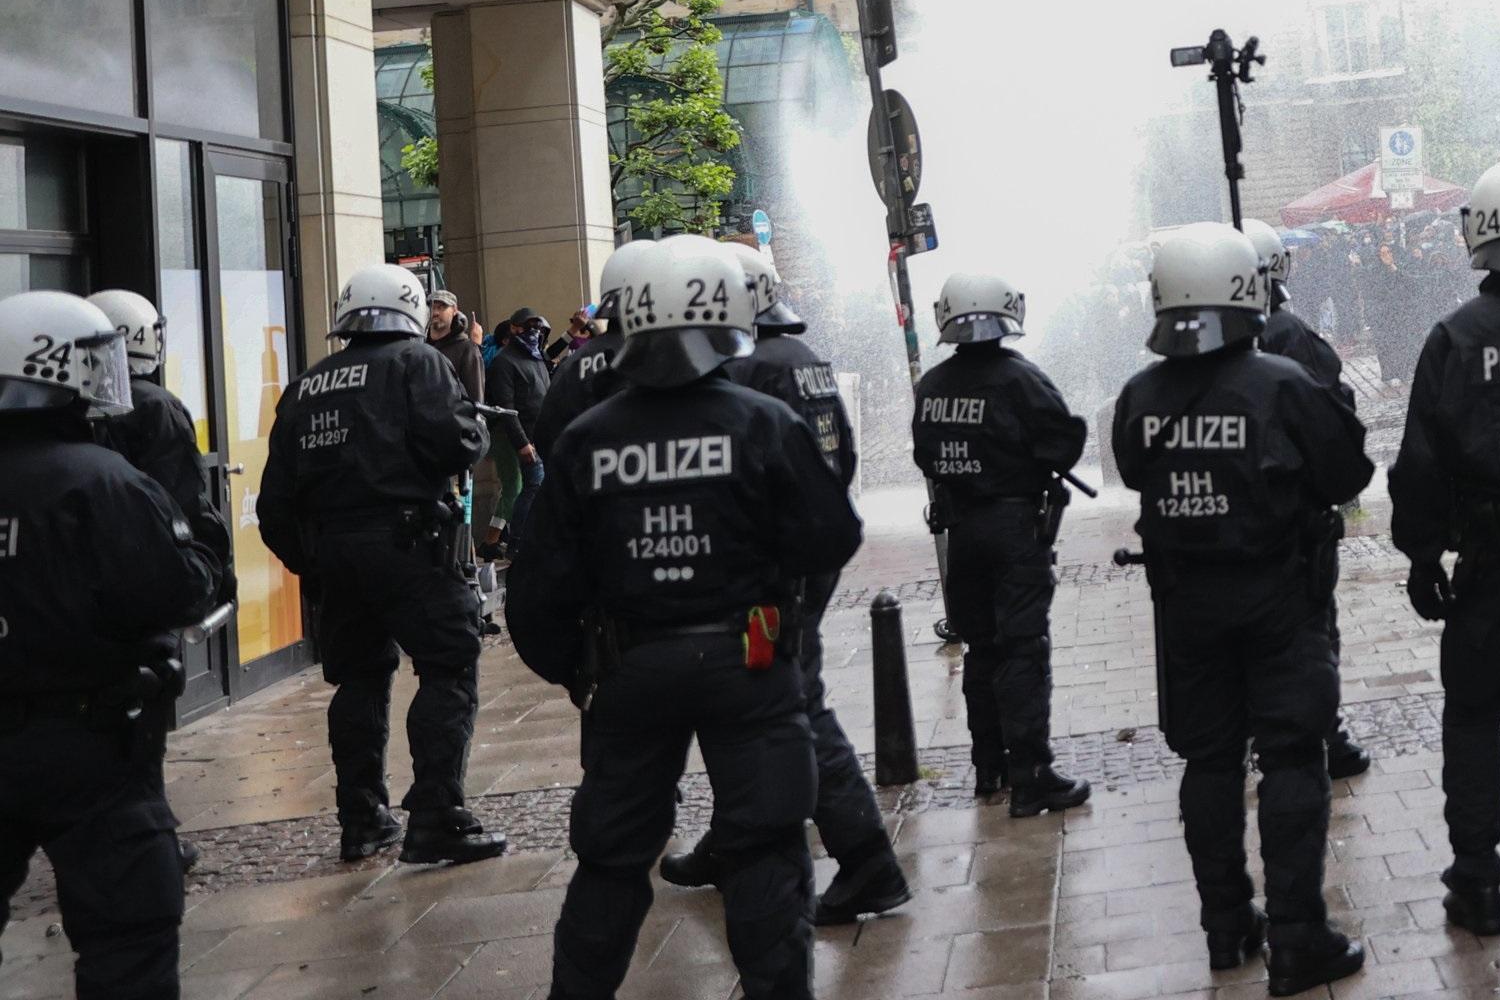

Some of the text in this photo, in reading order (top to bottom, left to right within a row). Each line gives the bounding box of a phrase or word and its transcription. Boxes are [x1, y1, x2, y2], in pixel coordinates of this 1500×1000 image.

[398, 284, 420, 309] 24
[624, 283, 655, 315] 24
[685, 278, 728, 309] 24
[1230, 275, 1257, 301] 24
[1004, 292, 1019, 314] 24
[25, 334, 72, 369] 24
[298, 364, 368, 400] POLIZEI
[311, 409, 339, 432] HH
[921, 398, 985, 424] POLIZEI
[300, 428, 349, 450] 124297
[941, 441, 968, 458] HH
[592, 435, 732, 490] POLIZEI
[934, 460, 982, 474] 124343
[1170, 471, 1213, 496] HH
[643, 504, 694, 533] HH
[1157, 494, 1230, 517] 124233
[627, 533, 712, 559] 124001
